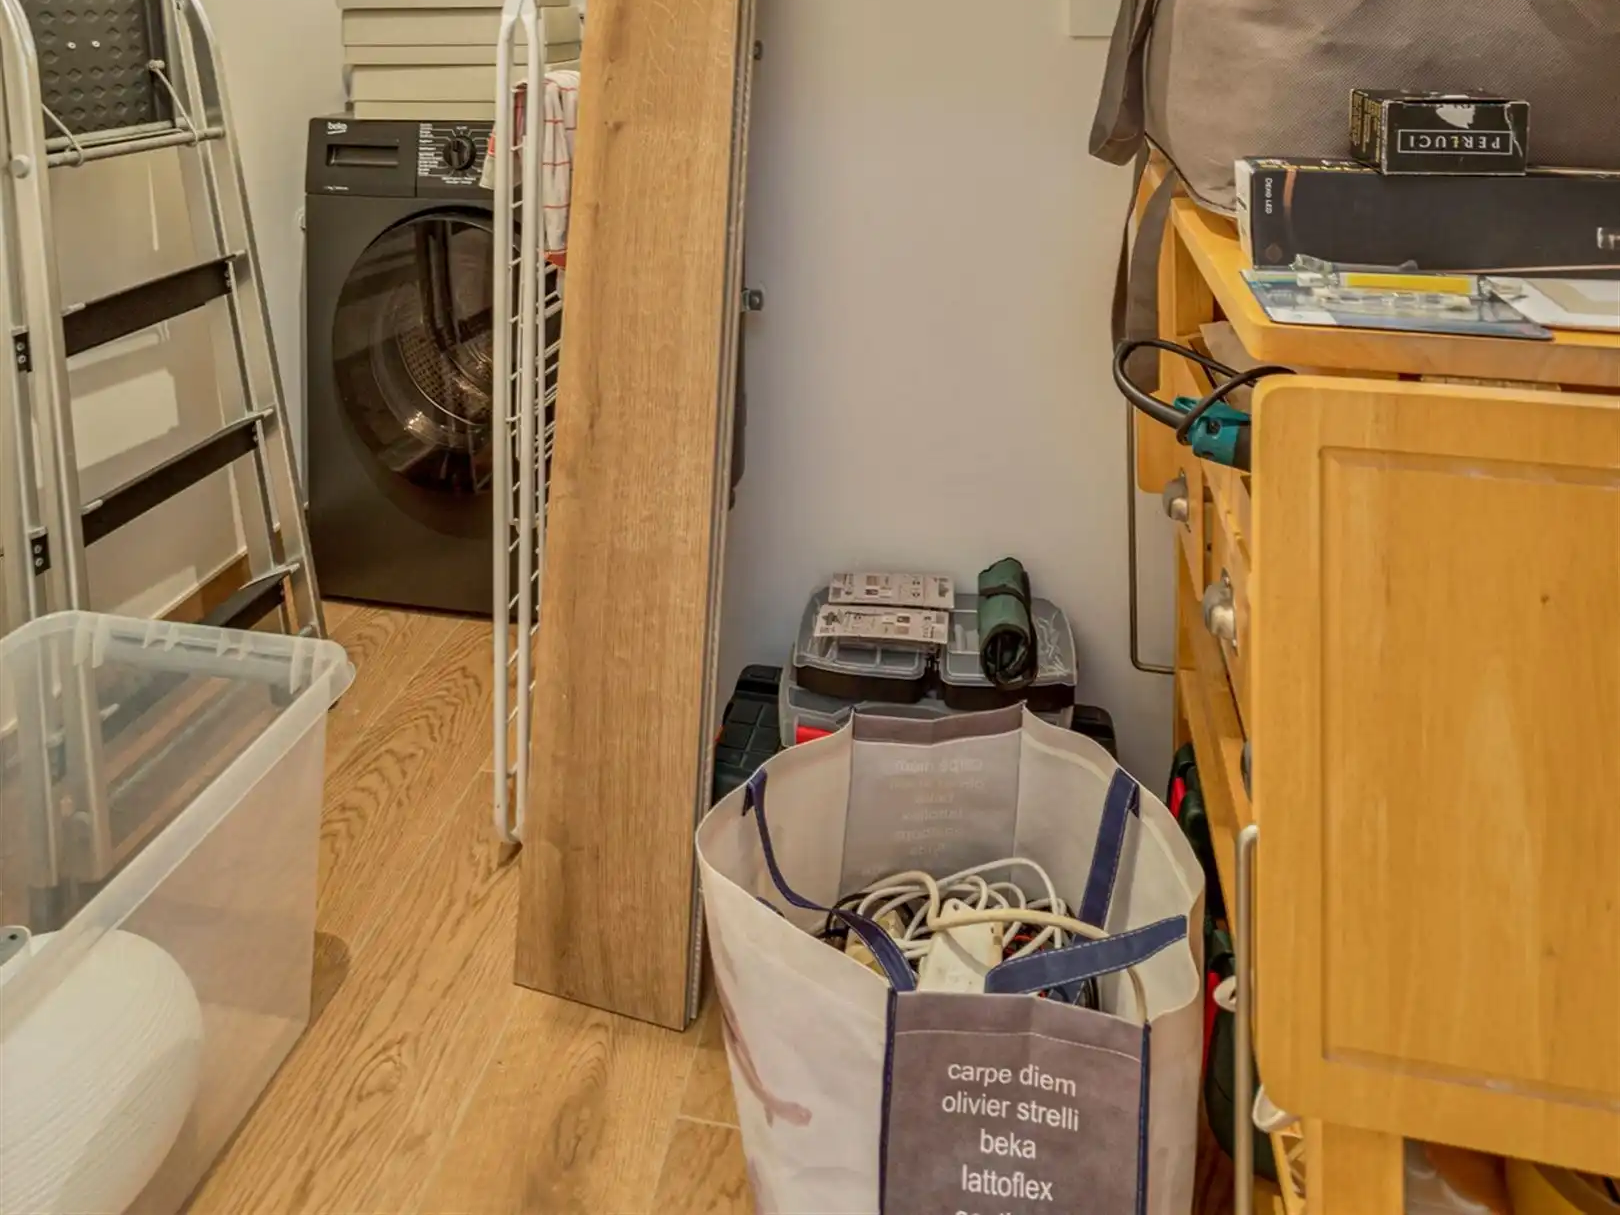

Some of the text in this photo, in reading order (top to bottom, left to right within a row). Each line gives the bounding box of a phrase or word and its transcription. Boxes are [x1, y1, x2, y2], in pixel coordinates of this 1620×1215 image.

[947, 1063, 1076, 1097] carpe diem
[941, 1091, 1079, 1132] olivier strelli
[979, 1128, 1036, 1159] beka
[962, 1164, 1053, 1201] lattoflex
